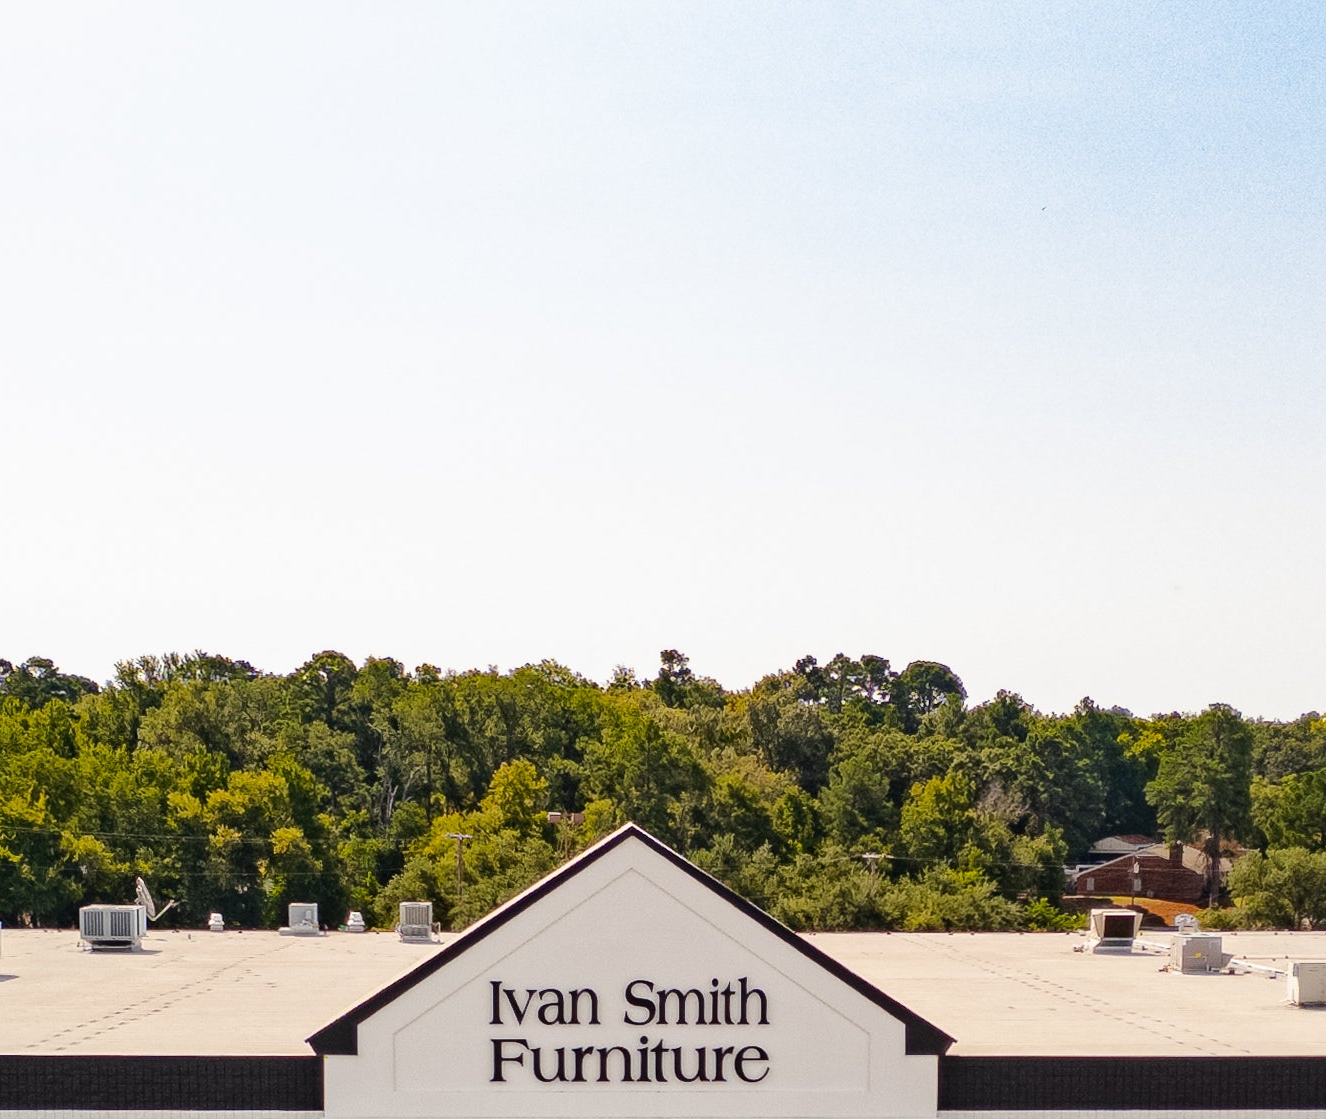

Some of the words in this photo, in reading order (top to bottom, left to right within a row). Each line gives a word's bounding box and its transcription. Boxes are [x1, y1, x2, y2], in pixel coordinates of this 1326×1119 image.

[489, 980, 601, 1026] Ivan
[623, 976, 770, 1026] Smith
[489, 1035, 770, 1083] Furniture
